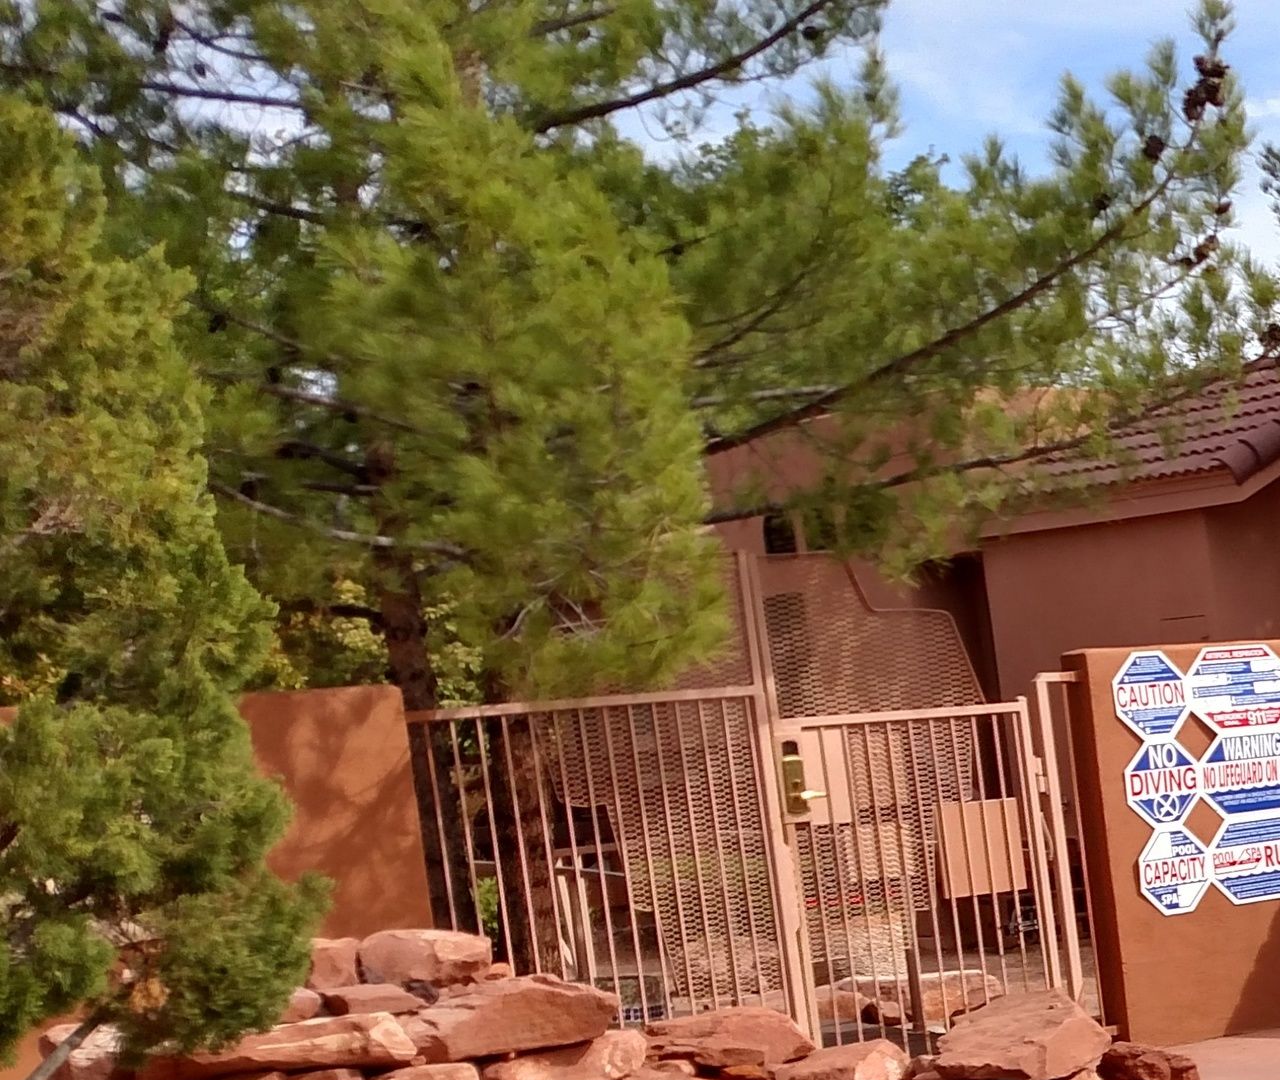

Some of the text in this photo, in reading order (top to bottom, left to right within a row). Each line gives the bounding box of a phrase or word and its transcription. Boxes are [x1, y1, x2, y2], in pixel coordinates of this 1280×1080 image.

[1116, 681, 1186, 708] CAUTION
[1247, 710, 1267, 725] 911
[1147, 743, 1177, 769] NO
[1130, 767, 1197, 797] DIVING
[1203, 766, 1216, 790] NO
[1218, 760, 1264, 788] LIFEGUARD
[1265, 759, 1278, 782] ON
[1172, 844, 1199, 857] POOL
[1144, 855, 1206, 886] CAPACITY
[1160, 892, 1179, 905] SPA
